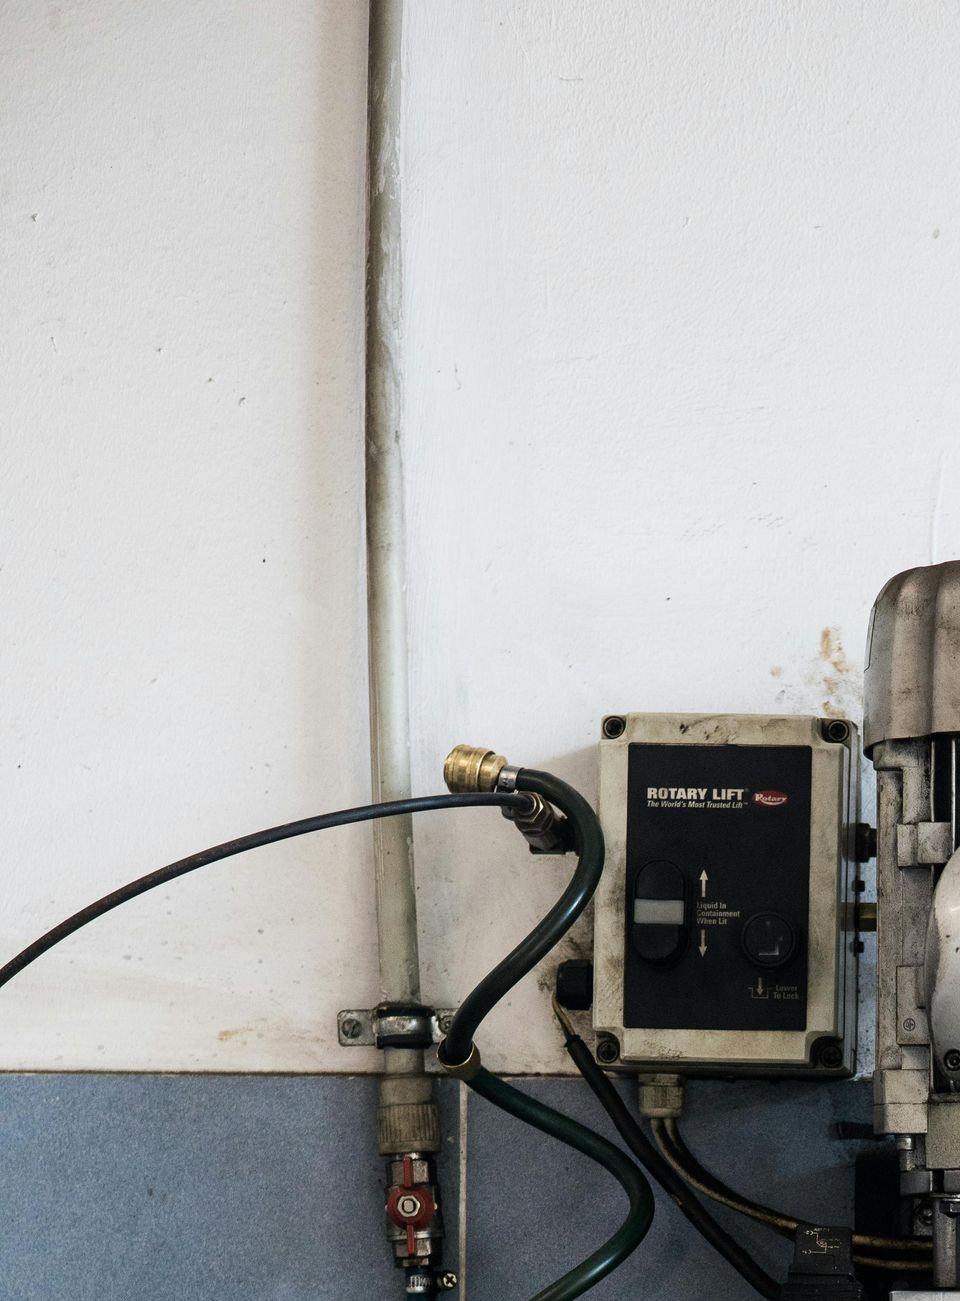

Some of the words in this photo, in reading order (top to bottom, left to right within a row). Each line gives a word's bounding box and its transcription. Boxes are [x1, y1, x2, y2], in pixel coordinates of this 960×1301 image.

[647, 787, 708, 800] ROTARY
[712, 788, 745, 801] LIFT
[754, 793, 788, 804] Rotary
[647, 800, 659, 808] The
[706, 801, 731, 809] Trusted
[696, 901, 718, 910] Liquid
[696, 909, 741, 918] Containment
[696, 917, 717, 925] When
